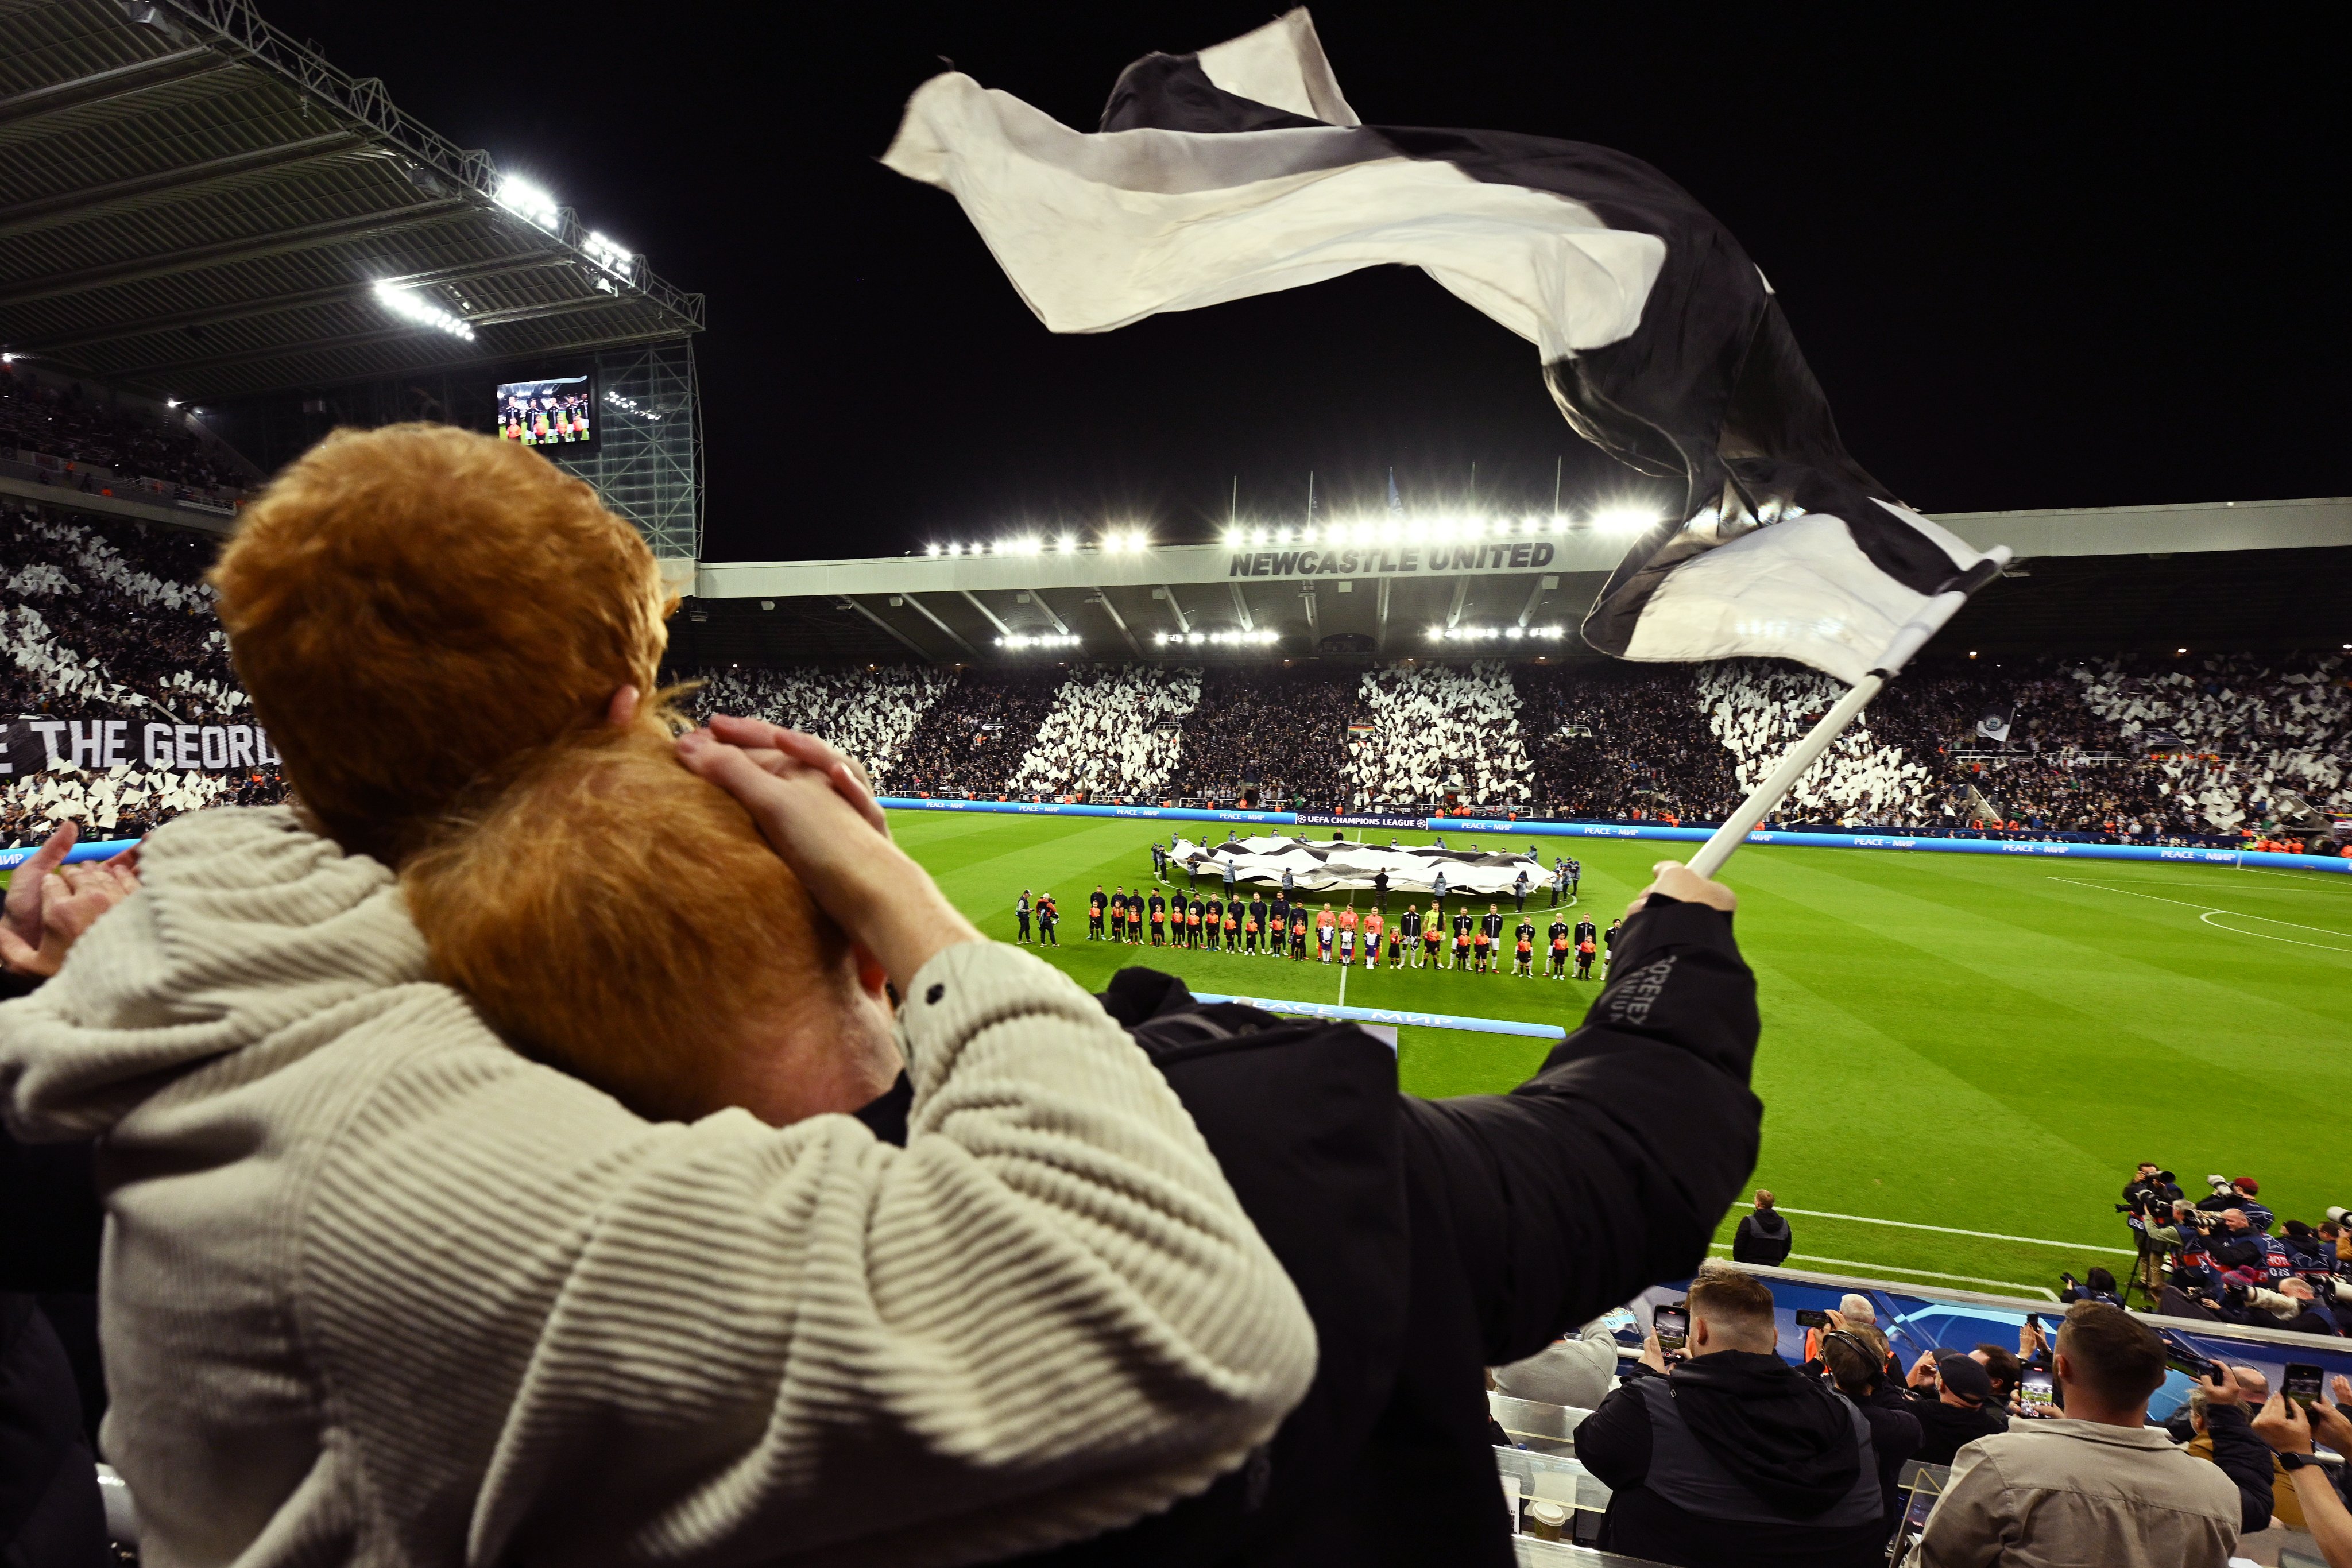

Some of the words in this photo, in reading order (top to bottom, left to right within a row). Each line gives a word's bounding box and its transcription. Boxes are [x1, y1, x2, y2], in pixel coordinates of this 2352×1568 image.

[1229, 547, 1421, 576] NEWCASTLE
[1428, 541, 1555, 570] UNITED
[30, 719, 128, 771] THE
[1330, 816, 1380, 826] CHAMPIONS
[1382, 818, 1415, 827] LEAGUE
[1584, 827, 1611, 835] PEACE
[1854, 837, 1884, 846] PEACE
[2002, 843, 2034, 853] PEACE
[2161, 850, 2196, 860] PEACE
[1371, 1011, 1453, 1025] МИР
